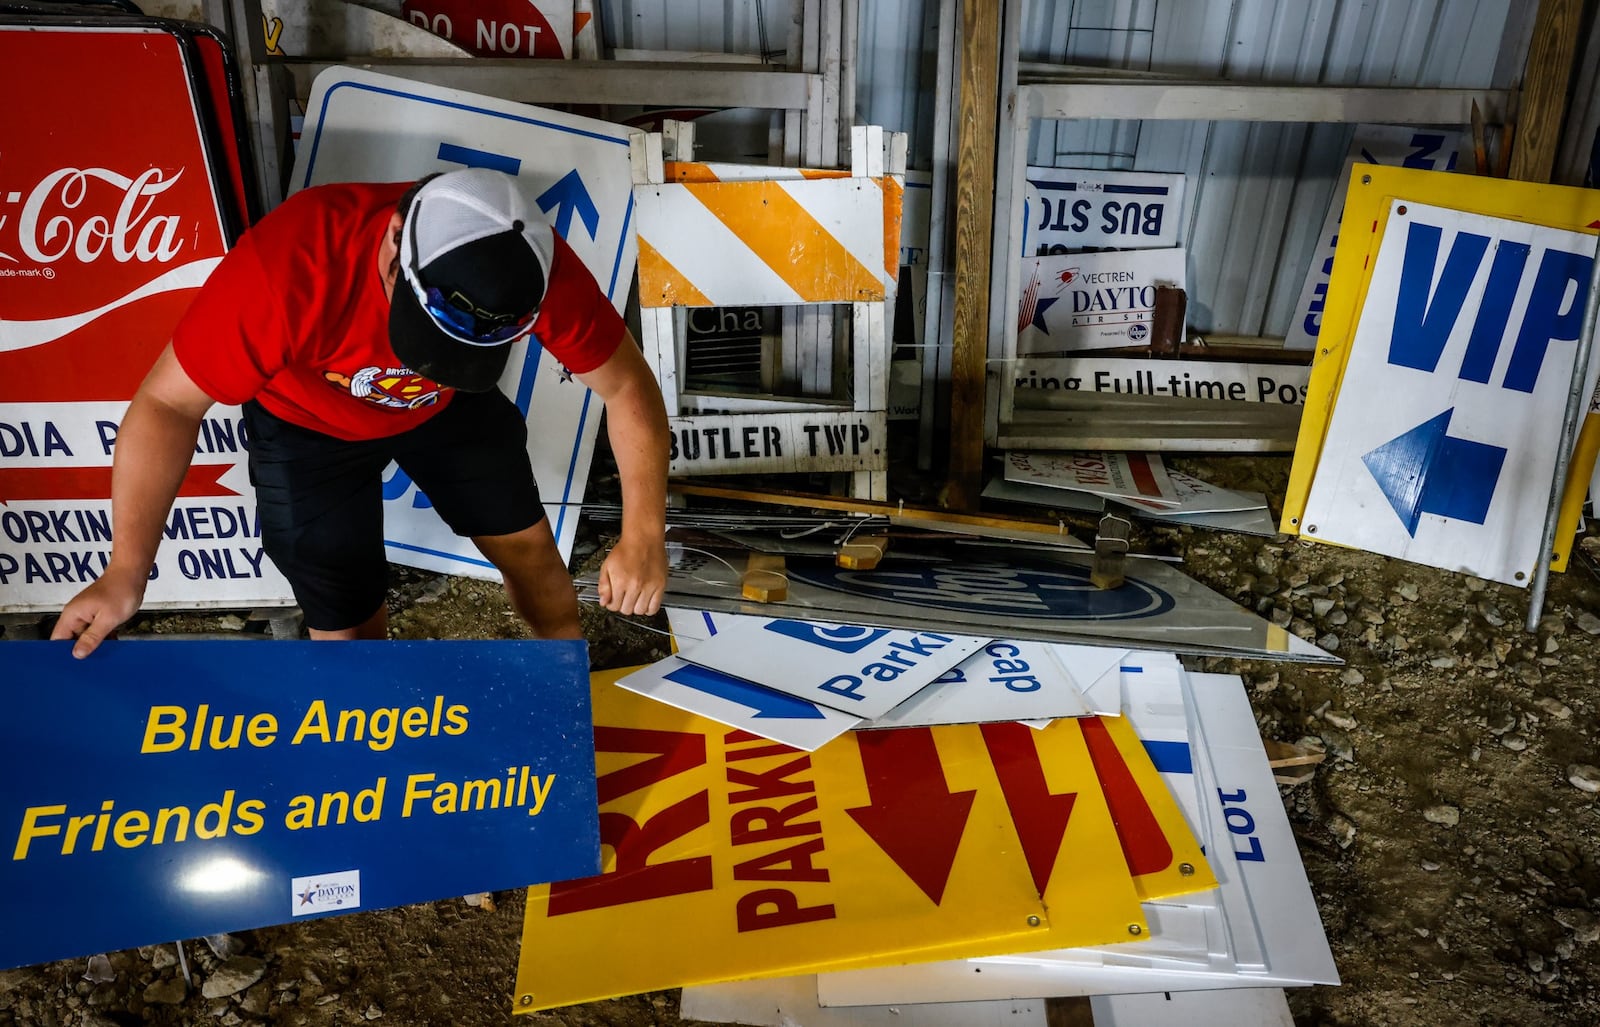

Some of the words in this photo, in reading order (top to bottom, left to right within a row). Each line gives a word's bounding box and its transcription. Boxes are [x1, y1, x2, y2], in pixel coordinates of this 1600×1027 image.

[476, 18, 542, 57] NOT
[1100, 201, 1165, 236] BUS
[1082, 271, 1135, 284] VECTREN
[687, 307, 762, 334] Cha
[1071, 316, 1104, 325] AIR
[1387, 221, 1595, 395] VIP
[1094, 370, 1246, 401] Full-time
[803, 423, 881, 458] TWP.
[178, 547, 265, 580] ONLY
[985, 643, 1042, 694] cap
[139, 703, 279, 754] Blue
[291, 695, 470, 751] Angels
[12, 789, 266, 861] Friends
[284, 777, 388, 830] and
[401, 765, 557, 816] Family
[547, 725, 714, 918] RV
[317, 883, 355, 897] DAYTON
